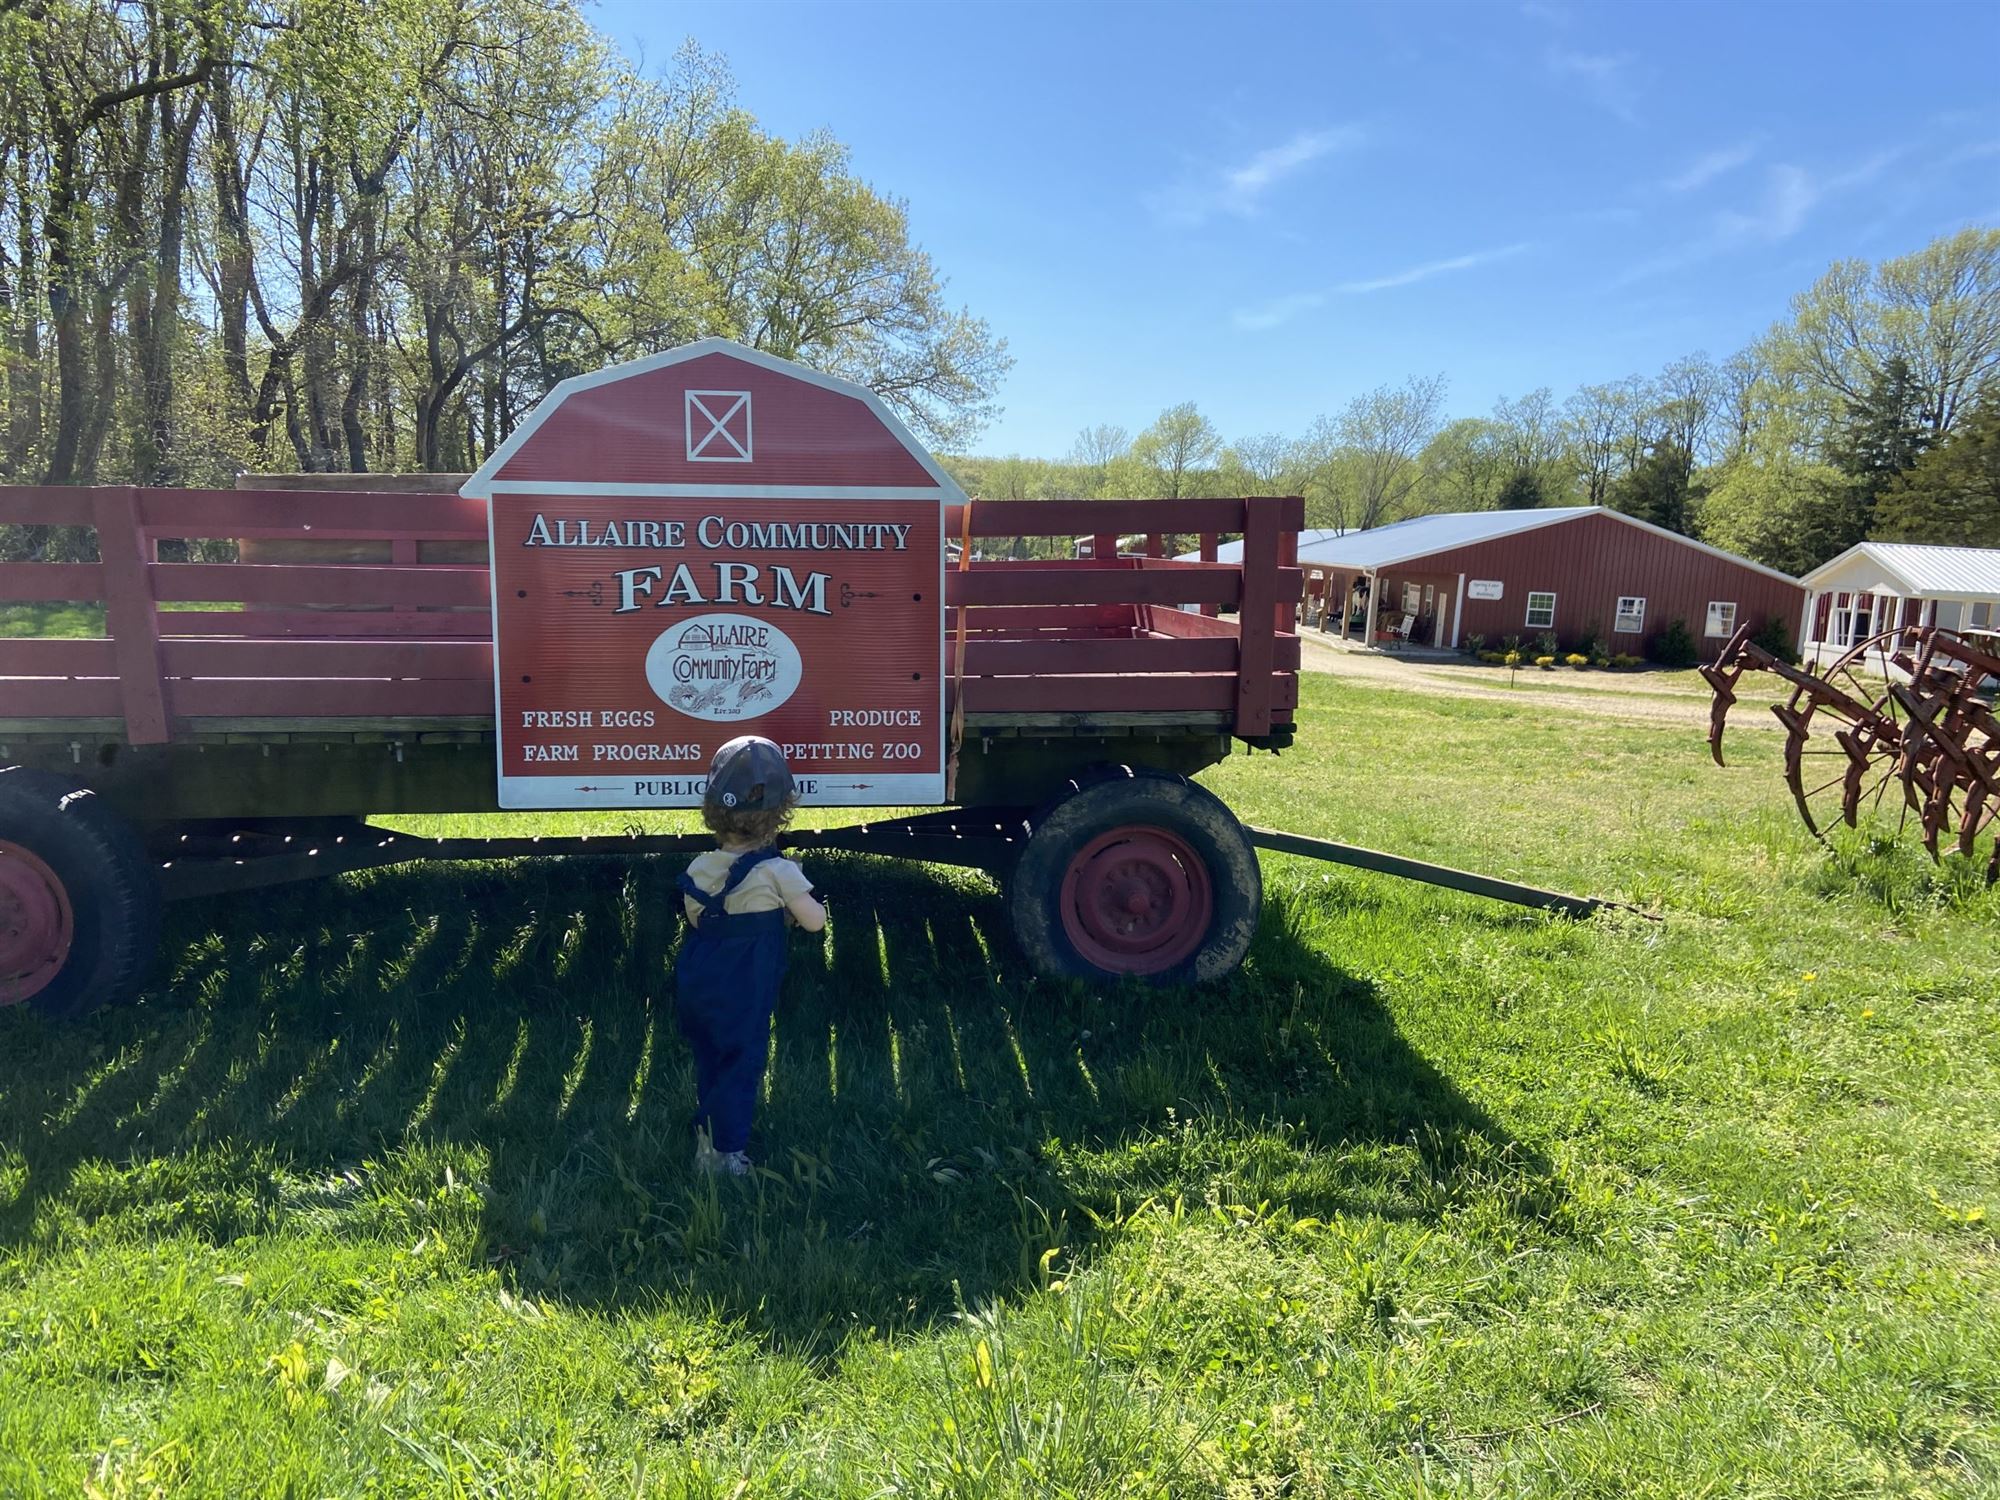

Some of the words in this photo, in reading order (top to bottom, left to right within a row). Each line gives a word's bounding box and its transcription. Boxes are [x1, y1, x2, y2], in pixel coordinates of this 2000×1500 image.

[524, 513, 686, 548] ALLAIRE
[697, 515, 912, 550] COMMUNITY
[613, 561, 832, 615] FARM
[522, 711, 593, 728] FRESH
[600, 711, 655, 728] EGGS
[829, 710, 921, 726] PRODUCE
[523, 745, 579, 762] FARM
[592, 744, 701, 761] PROGRAMS
[784, 743, 874, 760] PETTING
[882, 743, 921, 760] ZOO
[634, 781, 709, 796] PUBLIC
